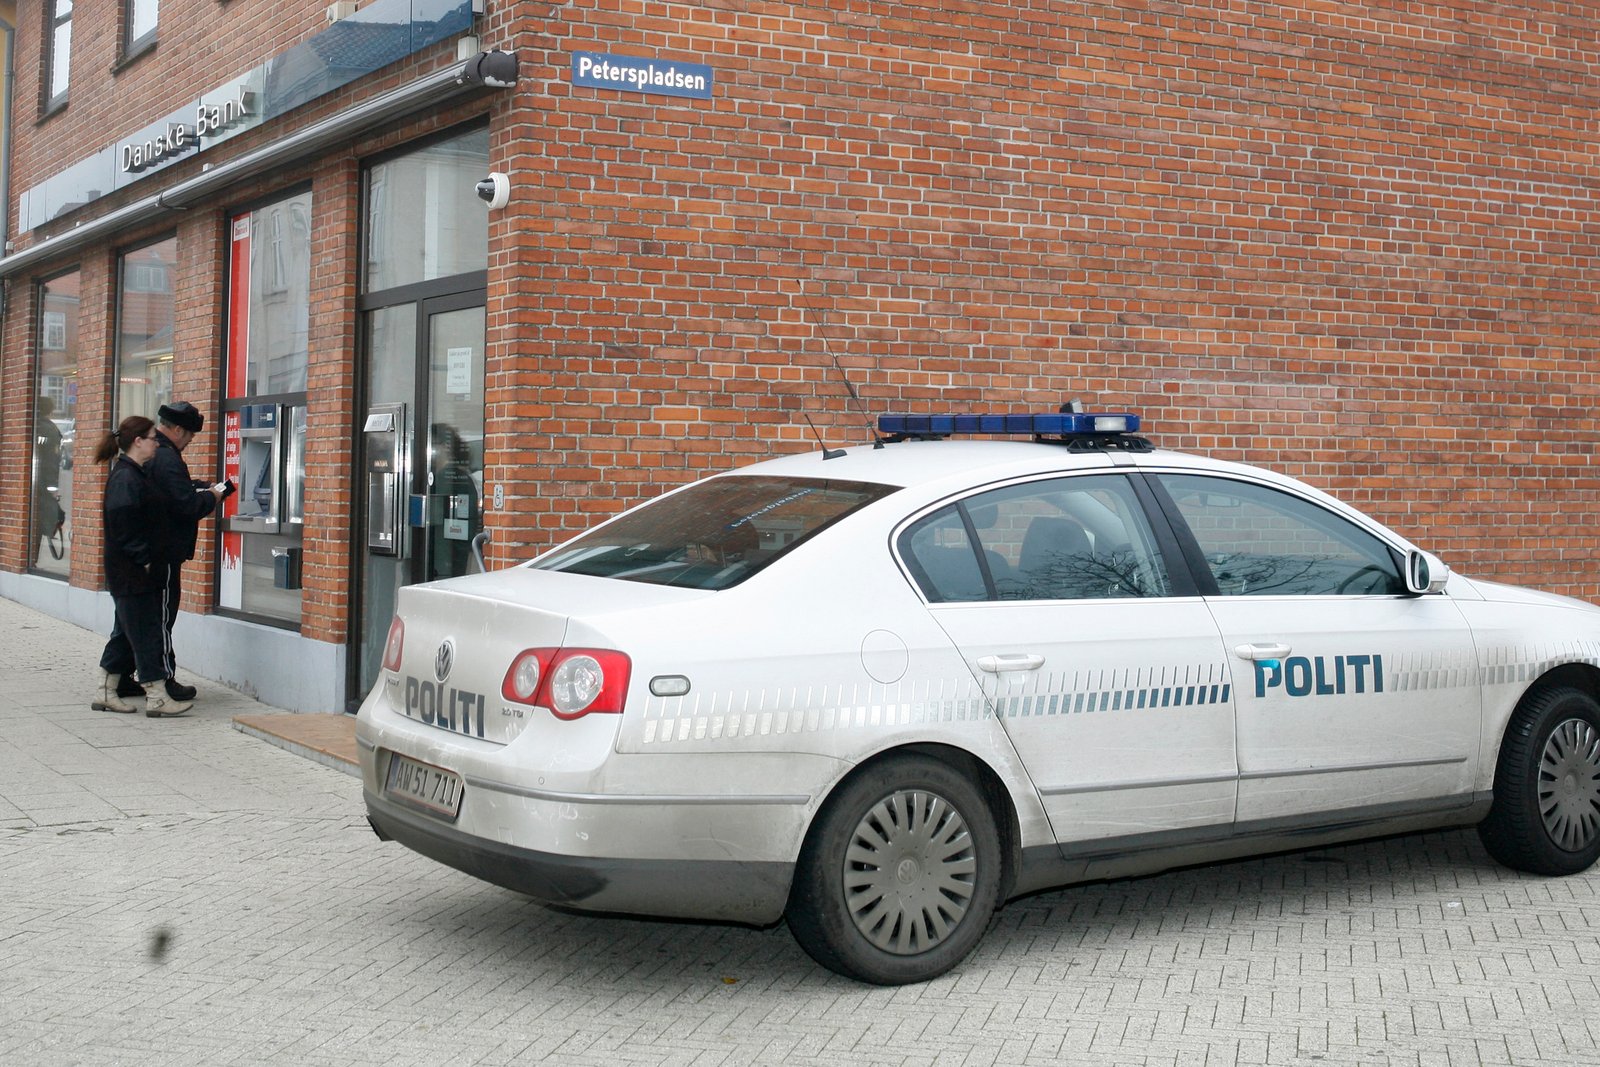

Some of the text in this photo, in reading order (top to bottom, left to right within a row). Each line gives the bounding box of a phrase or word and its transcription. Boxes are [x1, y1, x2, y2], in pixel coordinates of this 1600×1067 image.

[579, 57, 705, 90] Peterspladsen
[121, 85, 247, 172] Danske Bank
[1254, 654, 1384, 698] POLITI
[405, 676, 485, 738] POLITI
[395, 762, 458, 808] AW 51 711
